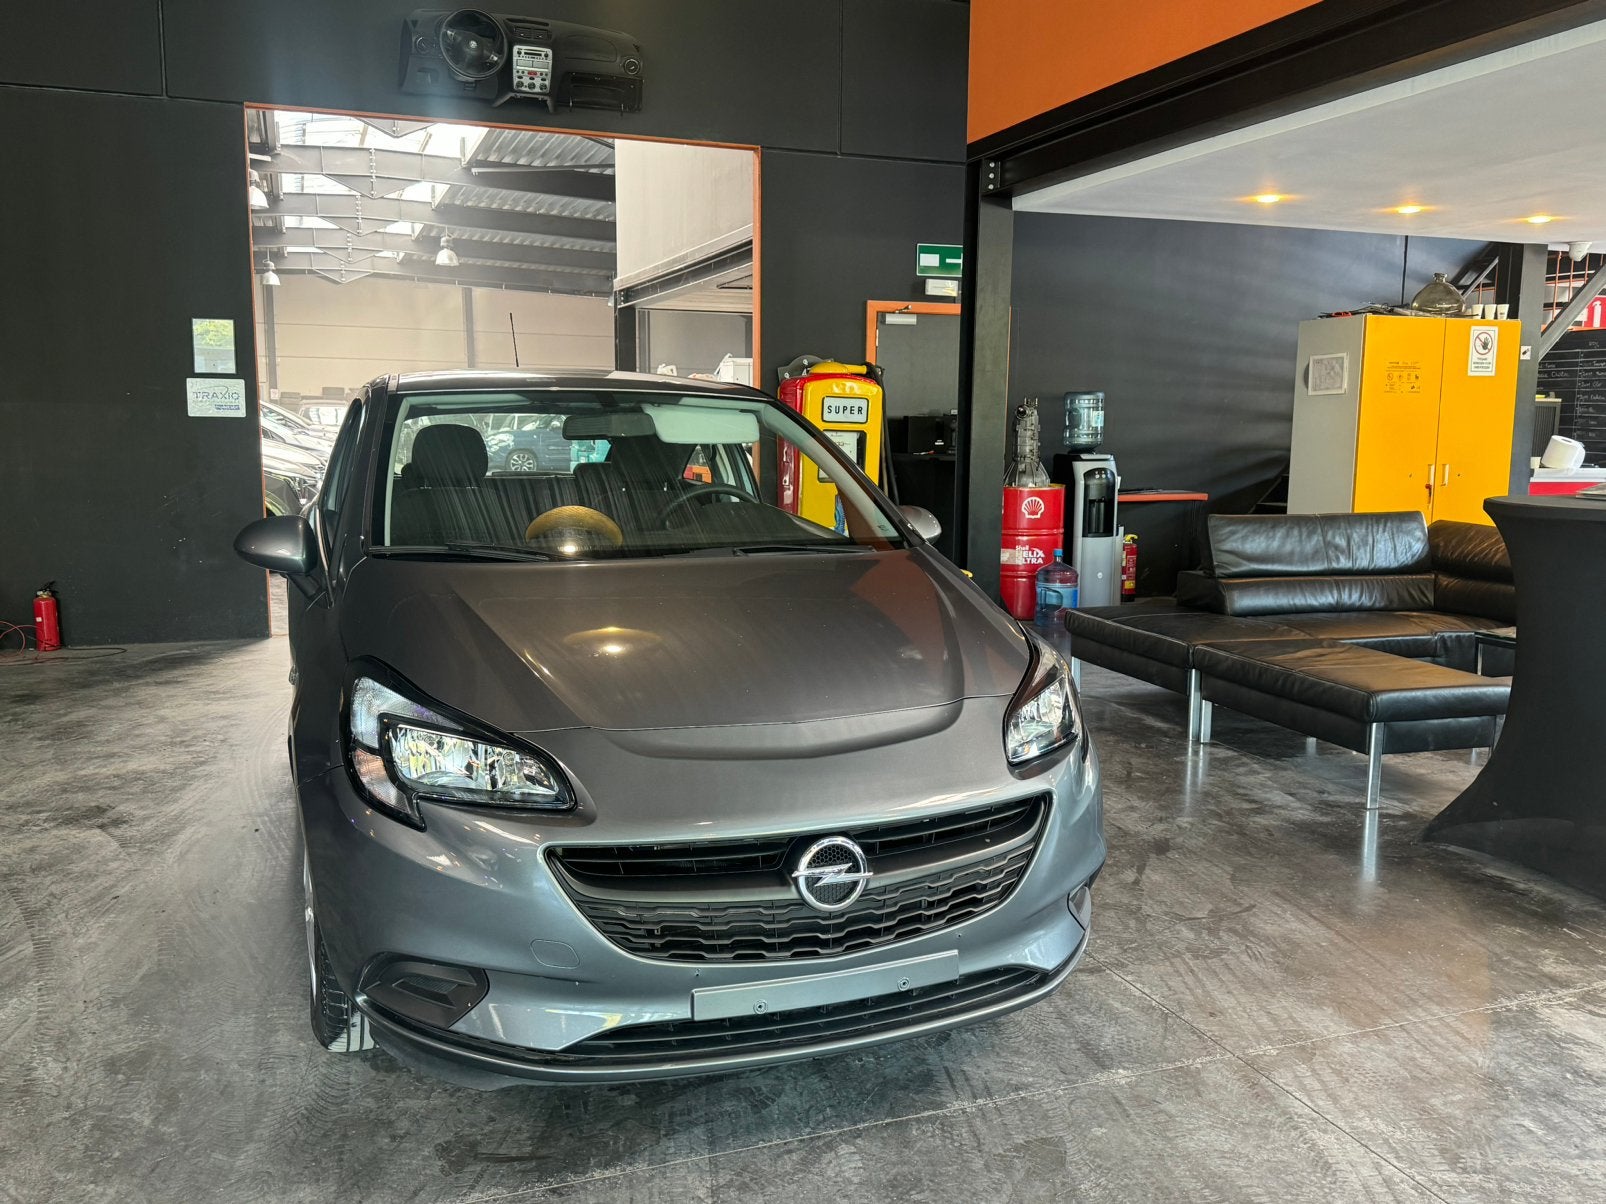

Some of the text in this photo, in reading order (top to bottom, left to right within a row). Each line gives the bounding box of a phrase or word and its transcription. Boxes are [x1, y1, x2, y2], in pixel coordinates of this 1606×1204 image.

[193, 391, 240, 400] TRAXIO
[827, 405, 863, 415] SUPER
[1016, 557, 1044, 565] LTRA
